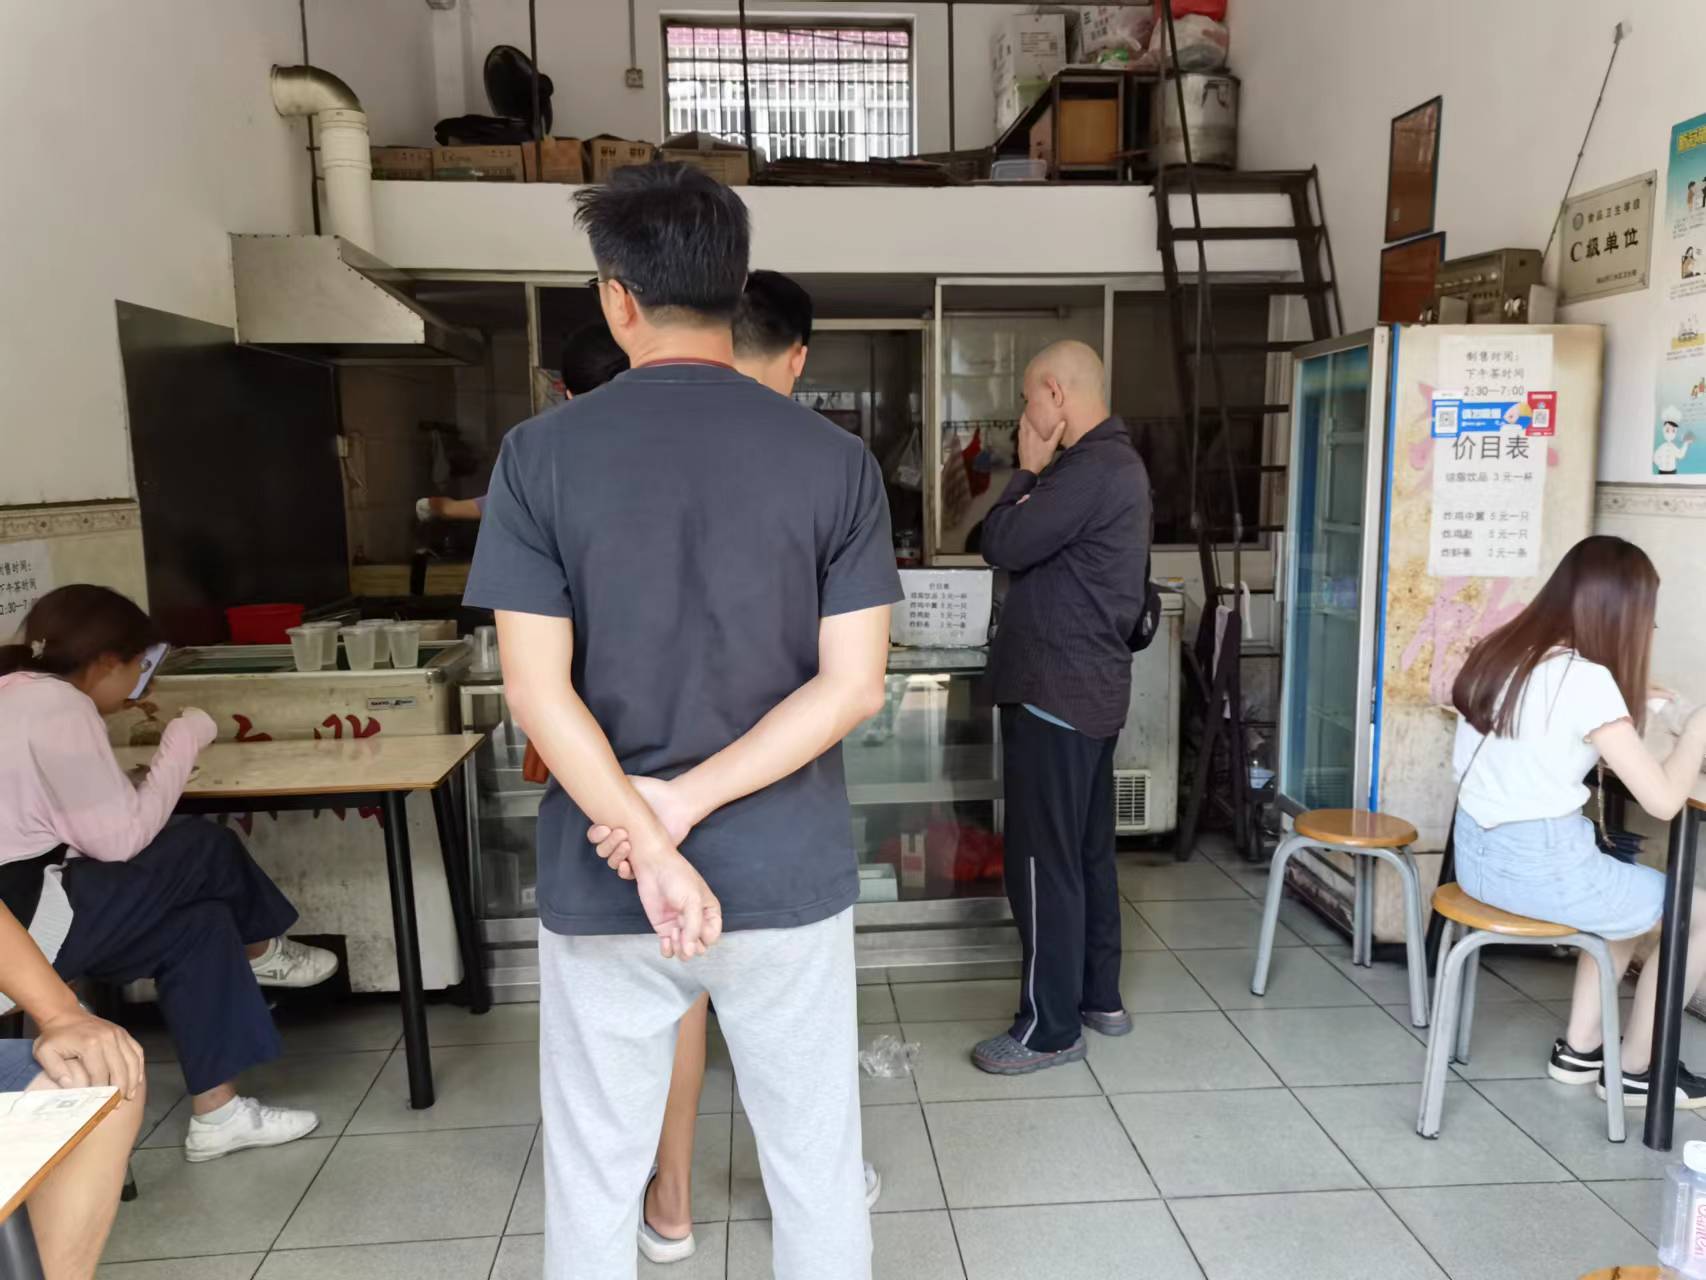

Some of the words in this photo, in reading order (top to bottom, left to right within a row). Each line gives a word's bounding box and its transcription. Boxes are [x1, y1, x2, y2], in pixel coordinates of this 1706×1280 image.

[1570, 227, 1639, 262] C级单位
[1452, 434, 1530, 461] 价目表
